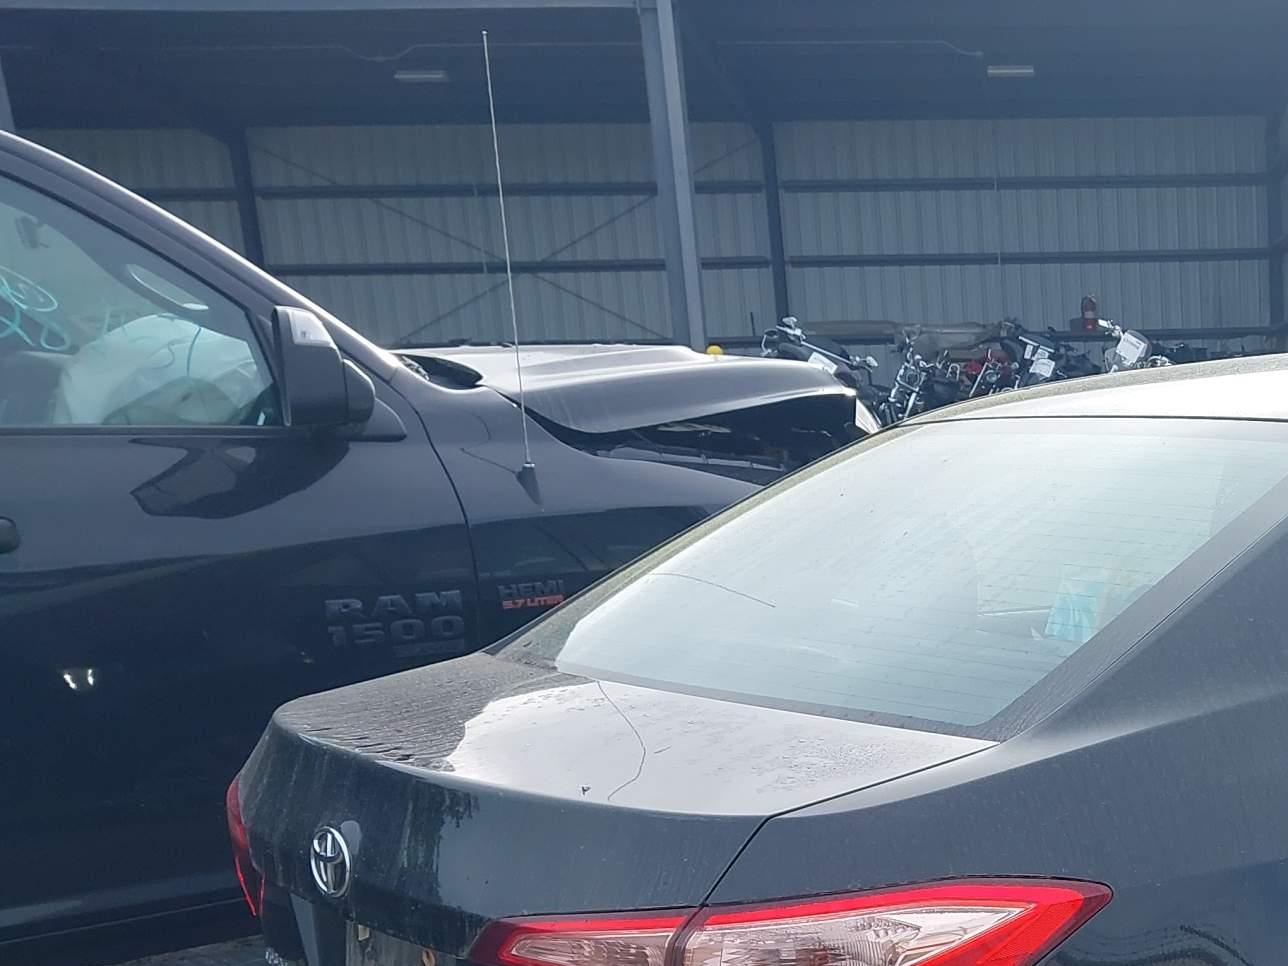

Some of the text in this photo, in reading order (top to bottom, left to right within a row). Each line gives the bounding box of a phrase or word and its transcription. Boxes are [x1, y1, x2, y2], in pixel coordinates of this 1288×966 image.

[498, 580, 564, 599] HEMI
[324, 590, 463, 624] RAM
[327, 615, 465, 648] 1500
